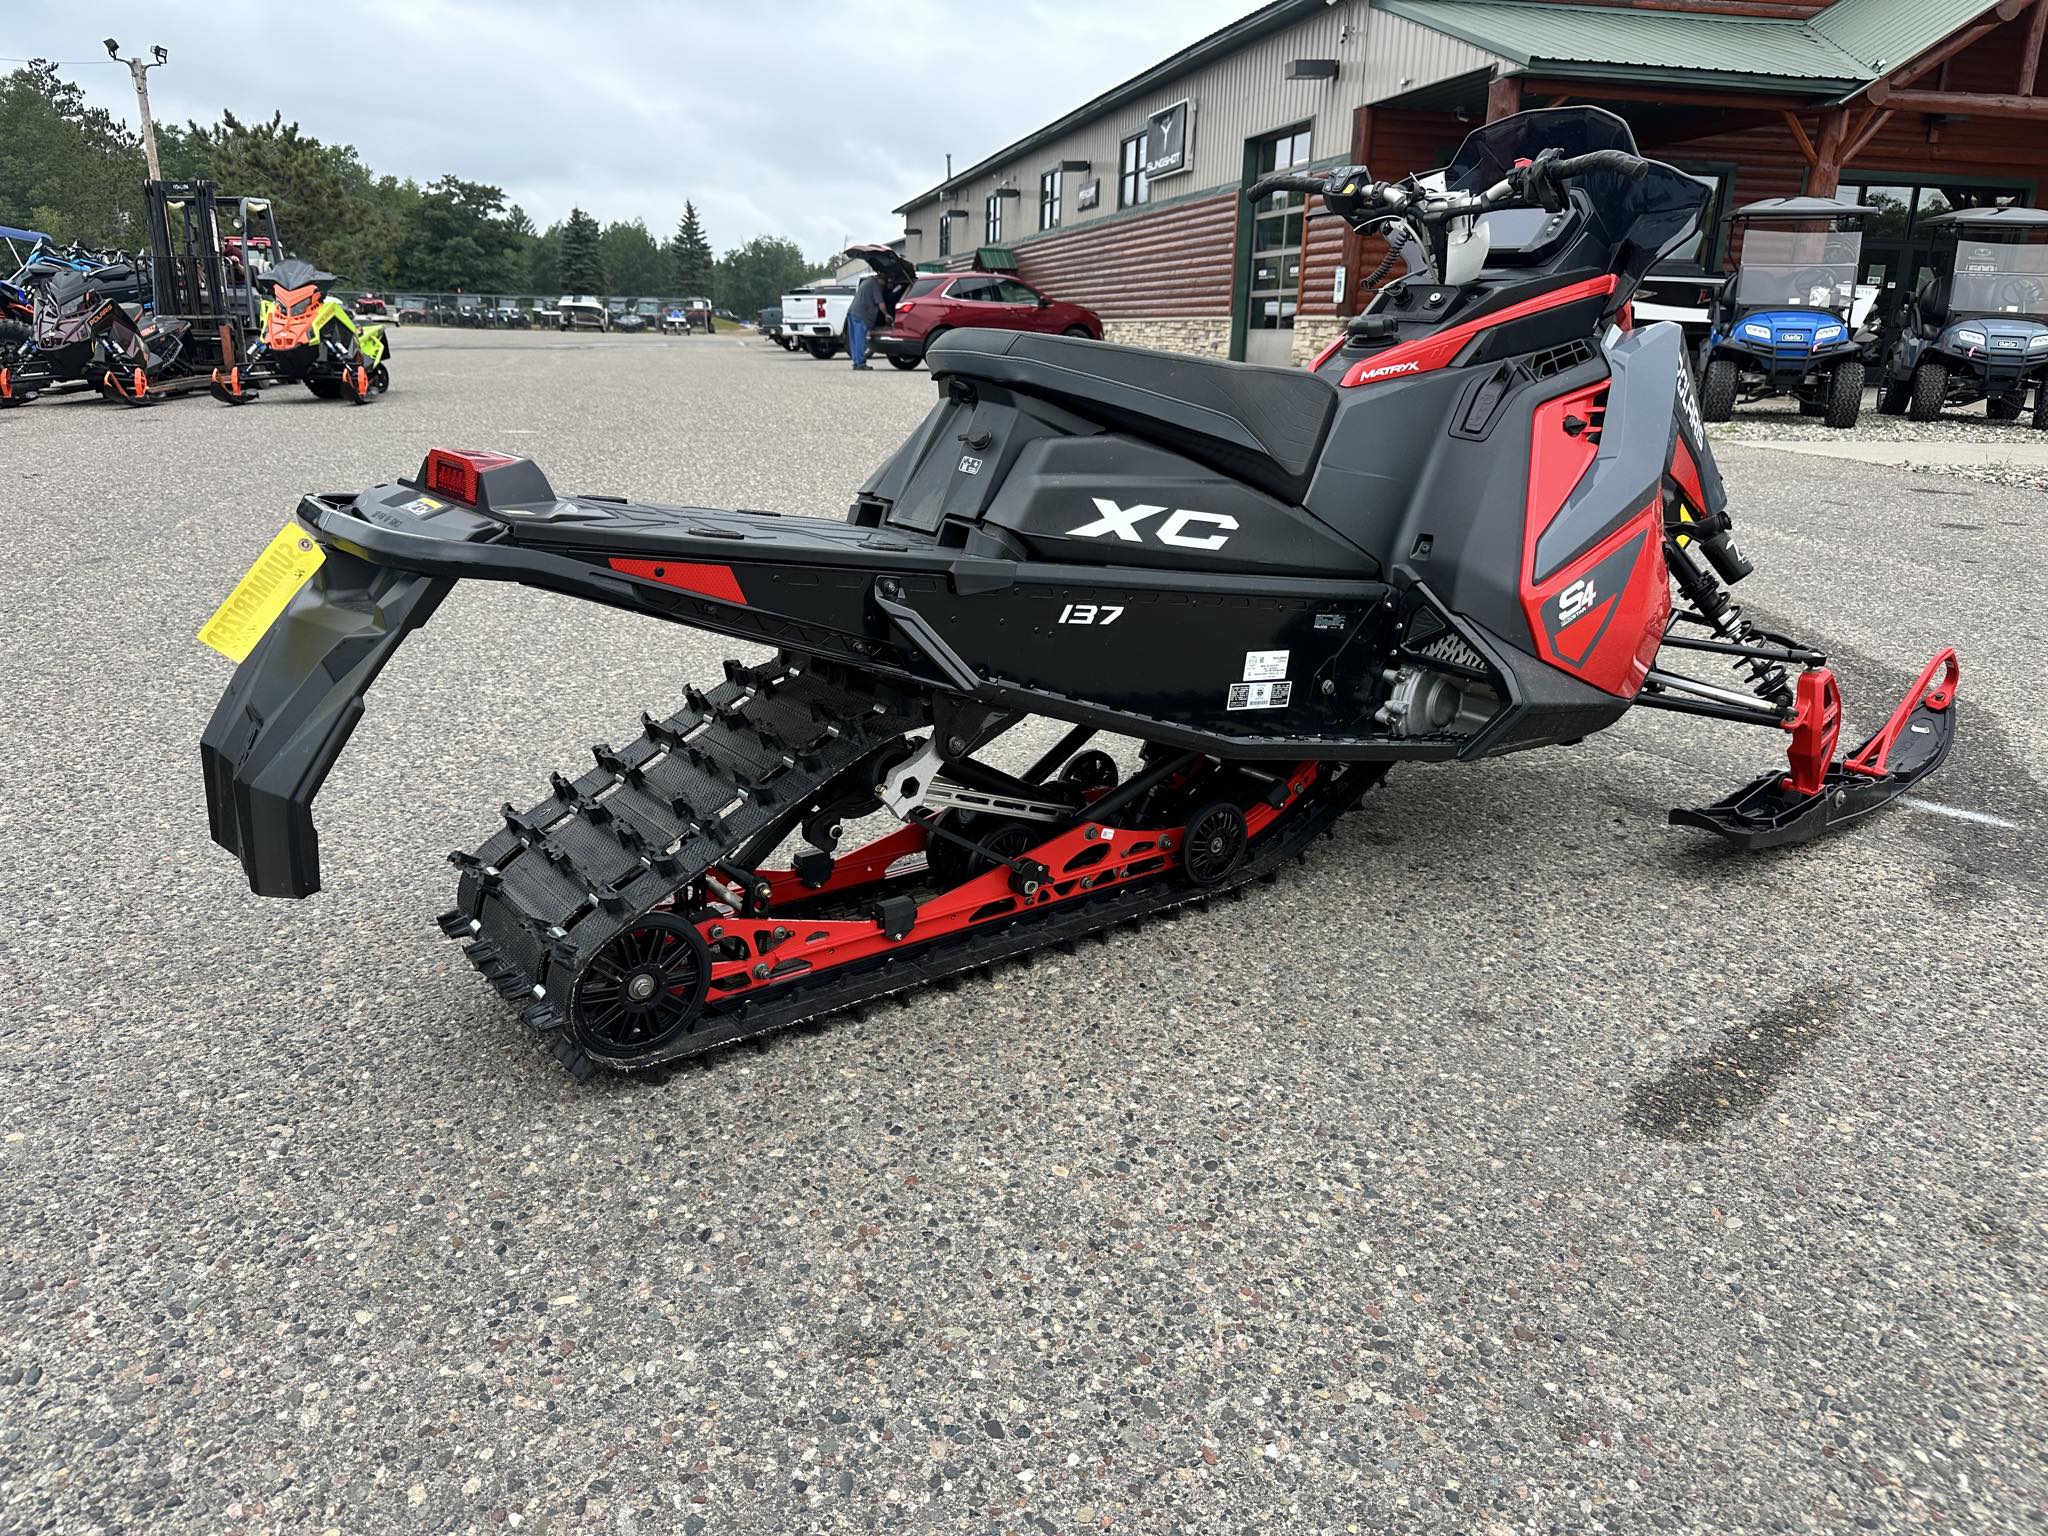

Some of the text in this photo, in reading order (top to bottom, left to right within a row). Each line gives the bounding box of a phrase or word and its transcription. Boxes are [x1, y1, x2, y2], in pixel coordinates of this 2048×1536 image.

[1146, 152, 1181, 173] SLINGSHOT
[89, 304, 113, 327] POLARIS
[1360, 361, 1419, 381] MATRYX
[1064, 497, 1240, 550] XC
[1558, 579, 1596, 620] S4
[1058, 604, 1124, 624] 137
